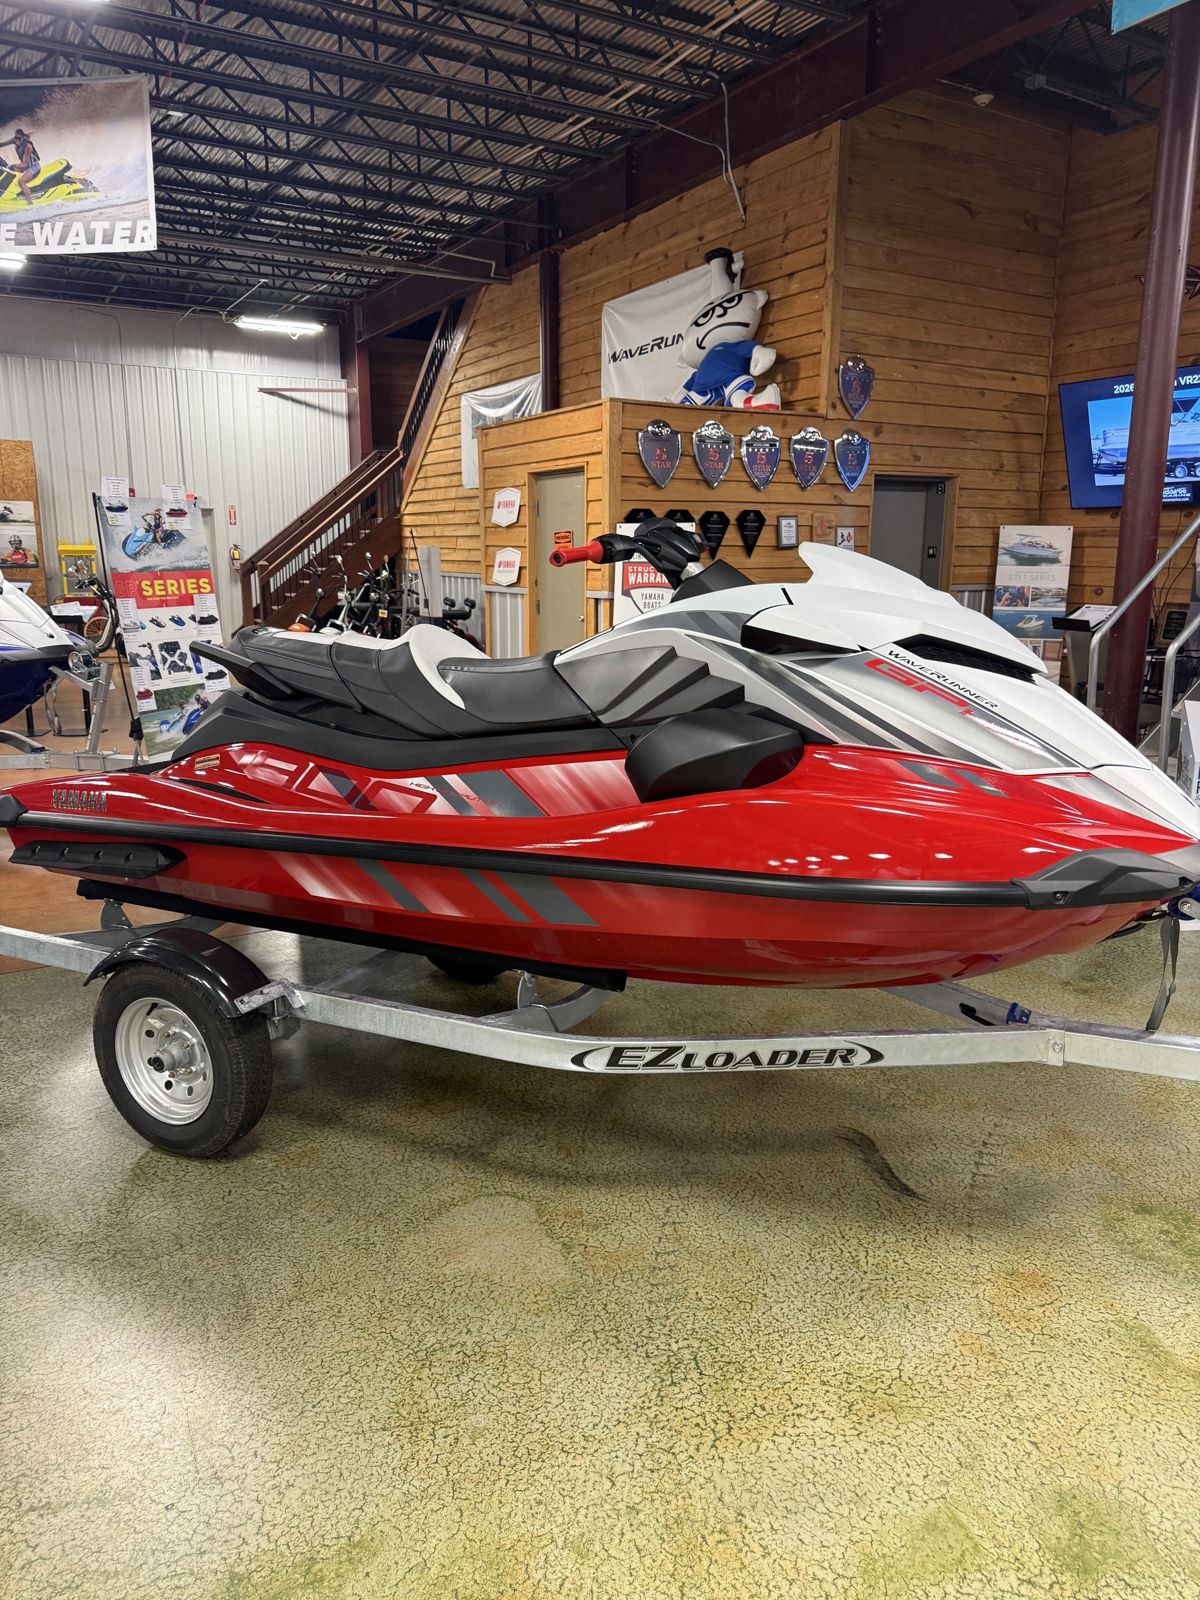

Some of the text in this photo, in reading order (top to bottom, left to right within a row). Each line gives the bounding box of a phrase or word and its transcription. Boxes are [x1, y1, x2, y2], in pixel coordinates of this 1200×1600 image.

[32, 220, 152, 246] WATER
[655, 447, 667, 461] 5
[708, 448, 719, 462] 5
[650, 460, 672, 469] STAR
[703, 461, 724, 470] STAR
[752, 464, 771, 472] STAR
[1030, 574, 1056, 582] SERIES
[141, 578, 211, 596] SERIES
[641, 592, 665, 601] YAMAHA
[643, 601, 662, 609] BOATS
[888, 649, 999, 709] WAVERUNNER
[51, 789, 107, 812] YAMAHA
